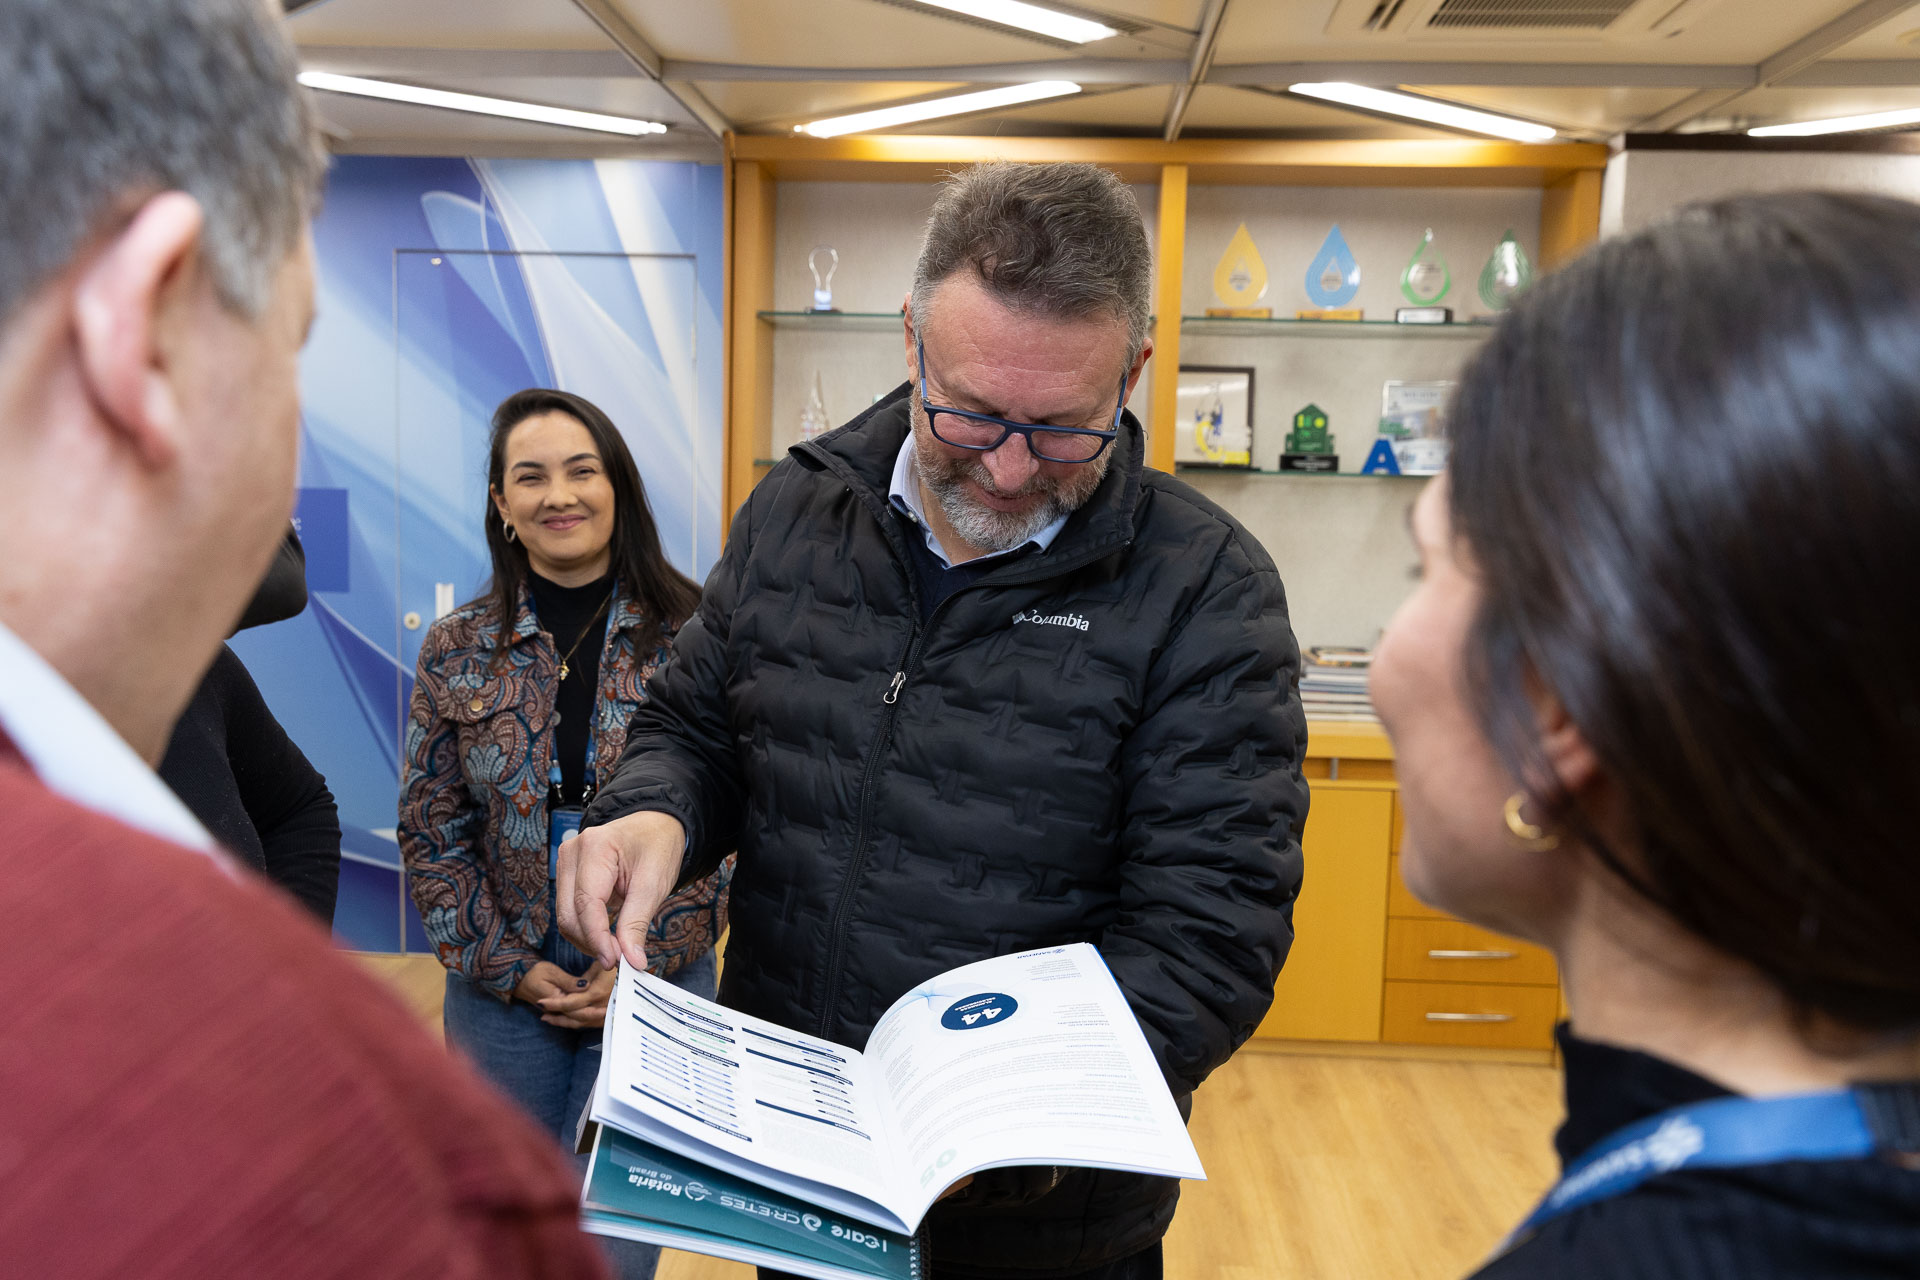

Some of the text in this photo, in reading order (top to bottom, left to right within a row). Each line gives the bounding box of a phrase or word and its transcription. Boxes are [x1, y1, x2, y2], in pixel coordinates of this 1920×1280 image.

[1022, 608, 1090, 631] Columbia
[961, 1007, 1002, 1026] 44
[629, 1165, 672, 1181] do Brasil
[628, 1174, 682, 1197] Rotária
